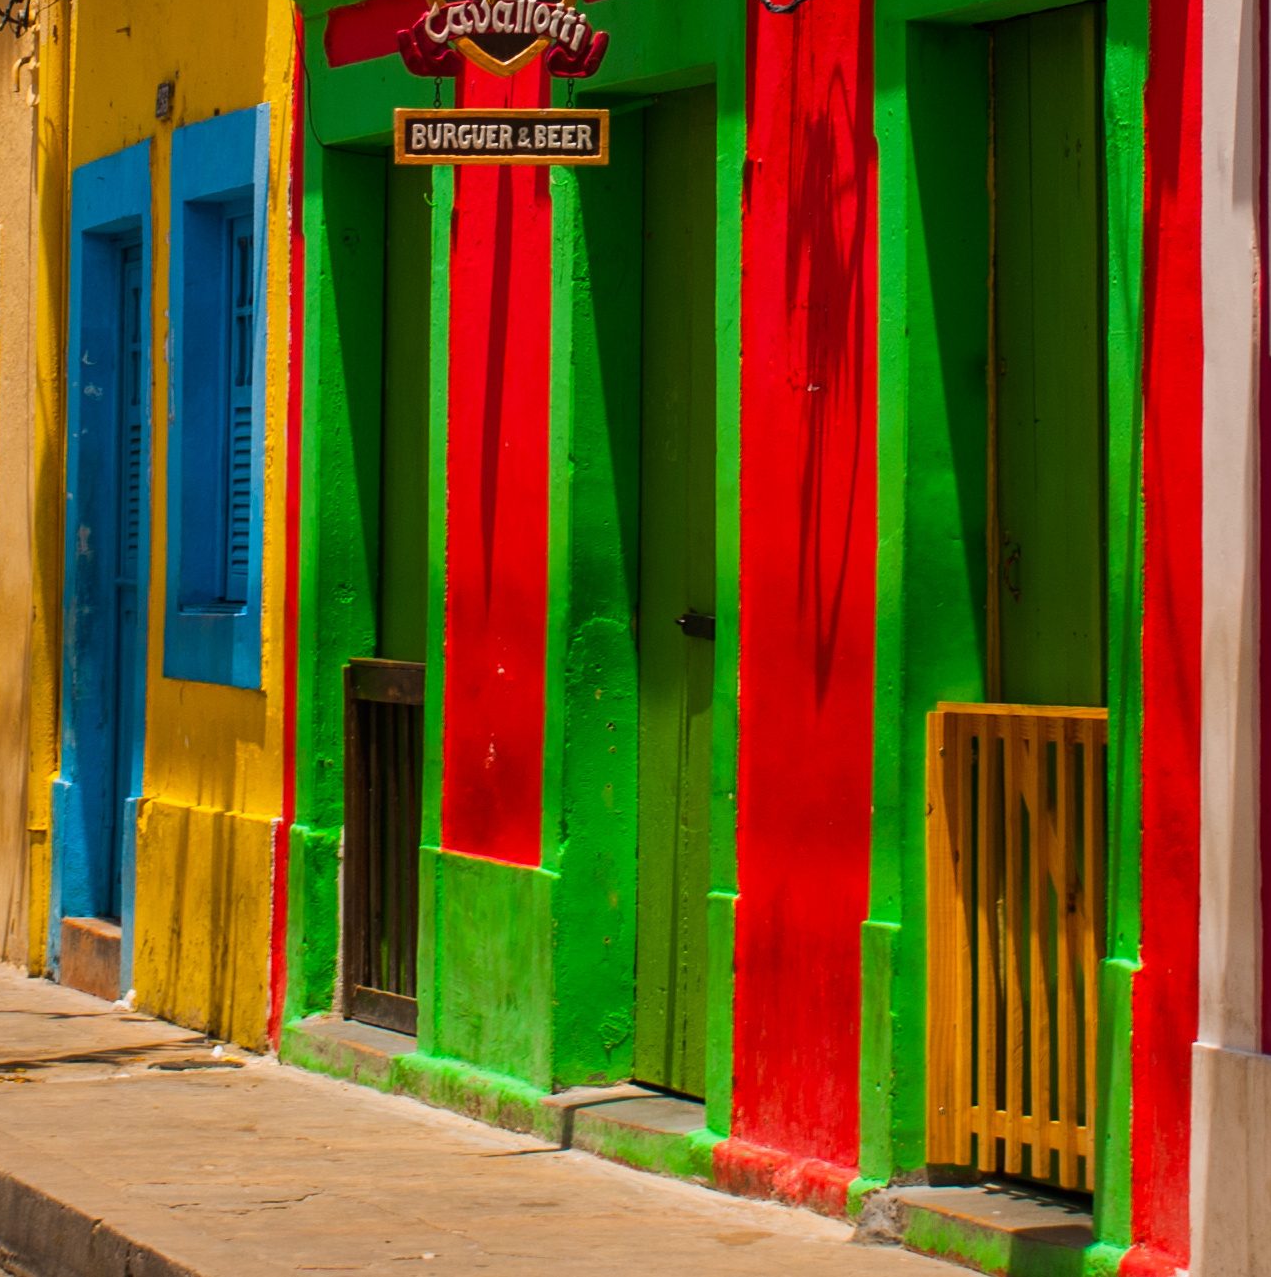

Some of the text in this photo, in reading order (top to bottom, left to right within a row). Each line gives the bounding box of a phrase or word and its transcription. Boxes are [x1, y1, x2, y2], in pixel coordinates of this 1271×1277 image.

[411, 123, 594, 151] BURGUER & BEER
